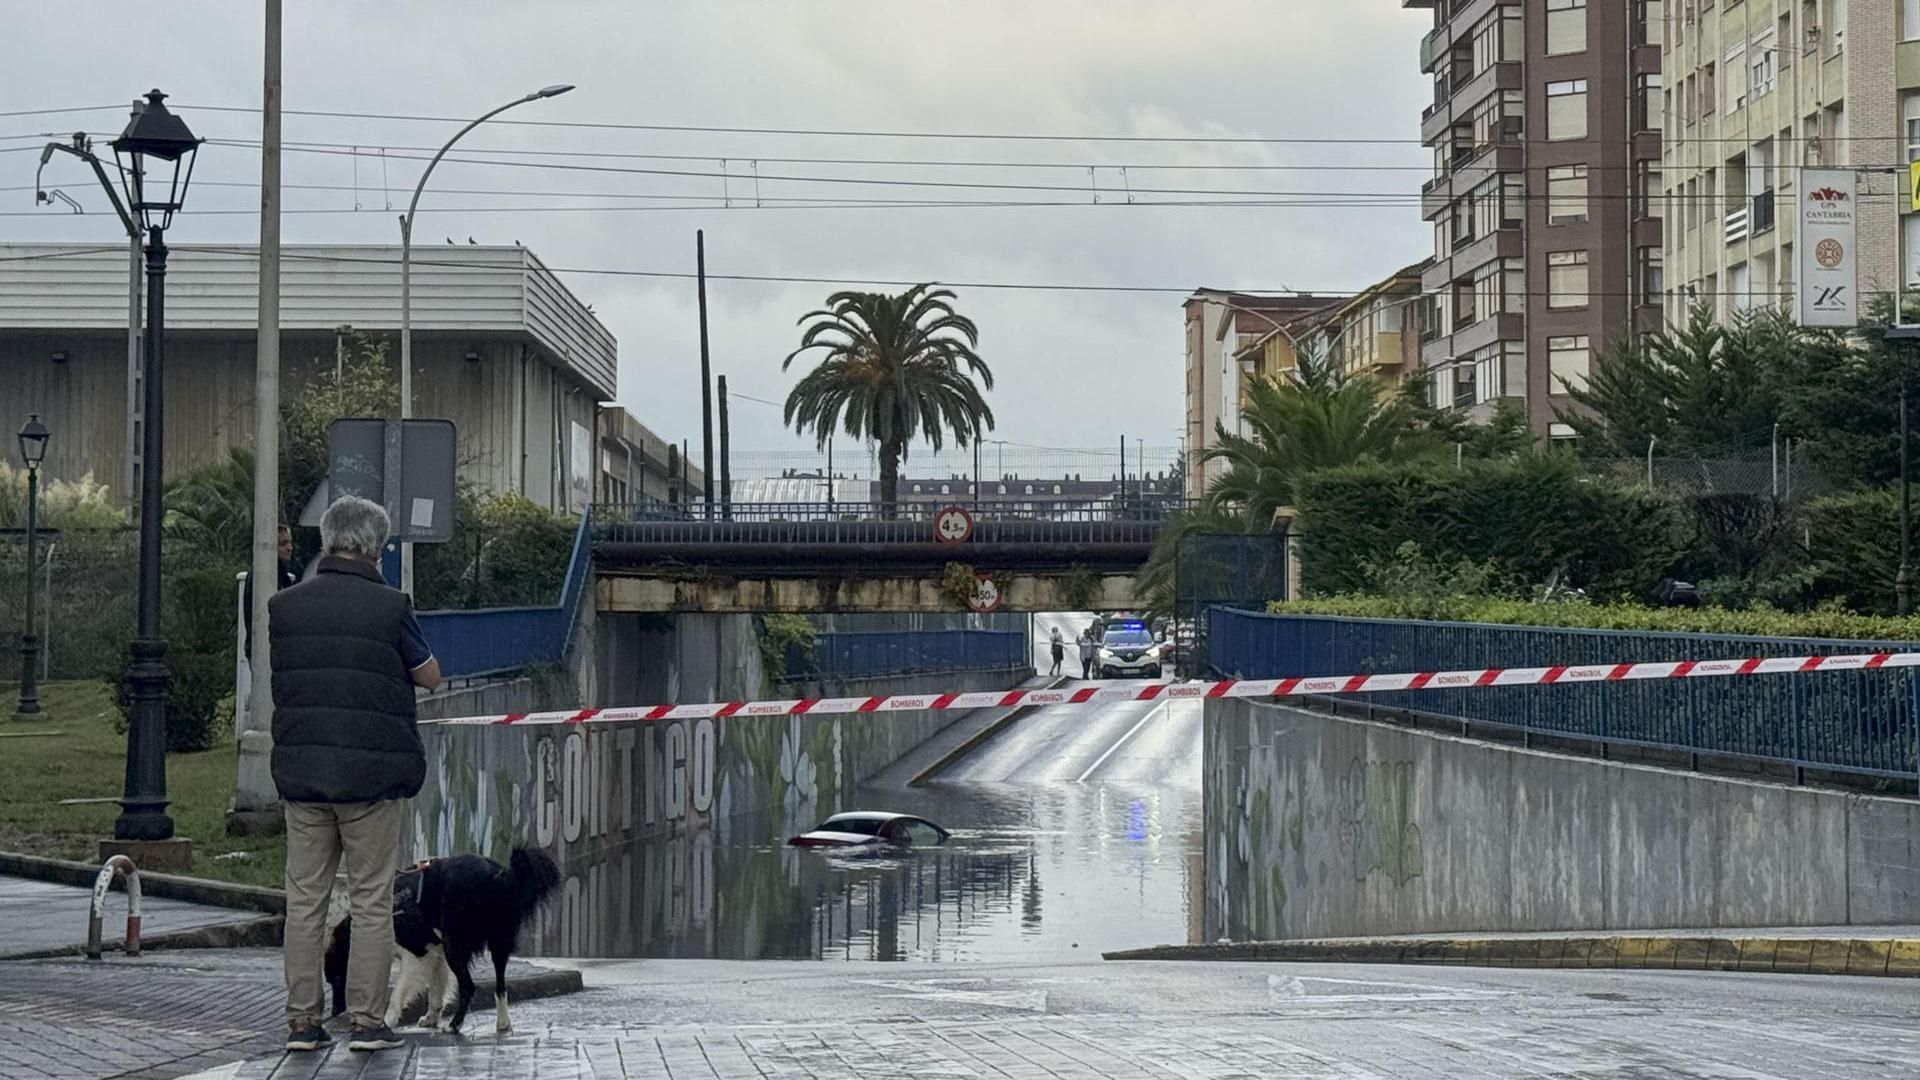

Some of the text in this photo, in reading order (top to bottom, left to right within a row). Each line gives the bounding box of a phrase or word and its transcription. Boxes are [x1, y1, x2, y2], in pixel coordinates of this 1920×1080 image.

[1806, 211, 1852, 219] CANTABRIA
[748, 705, 782, 714] BOMBEROS
[891, 699, 924, 708] BOMBEROS
[1030, 693, 1063, 702] BOMBEROS
[1168, 687, 1200, 697] BOMBEROS
[1304, 681, 1336, 690] BOMBEROS
[1438, 674, 1470, 684] BOMBEROS
[1569, 668, 1602, 678] BOMBEROS
[536, 718, 716, 849] CONTIGO
